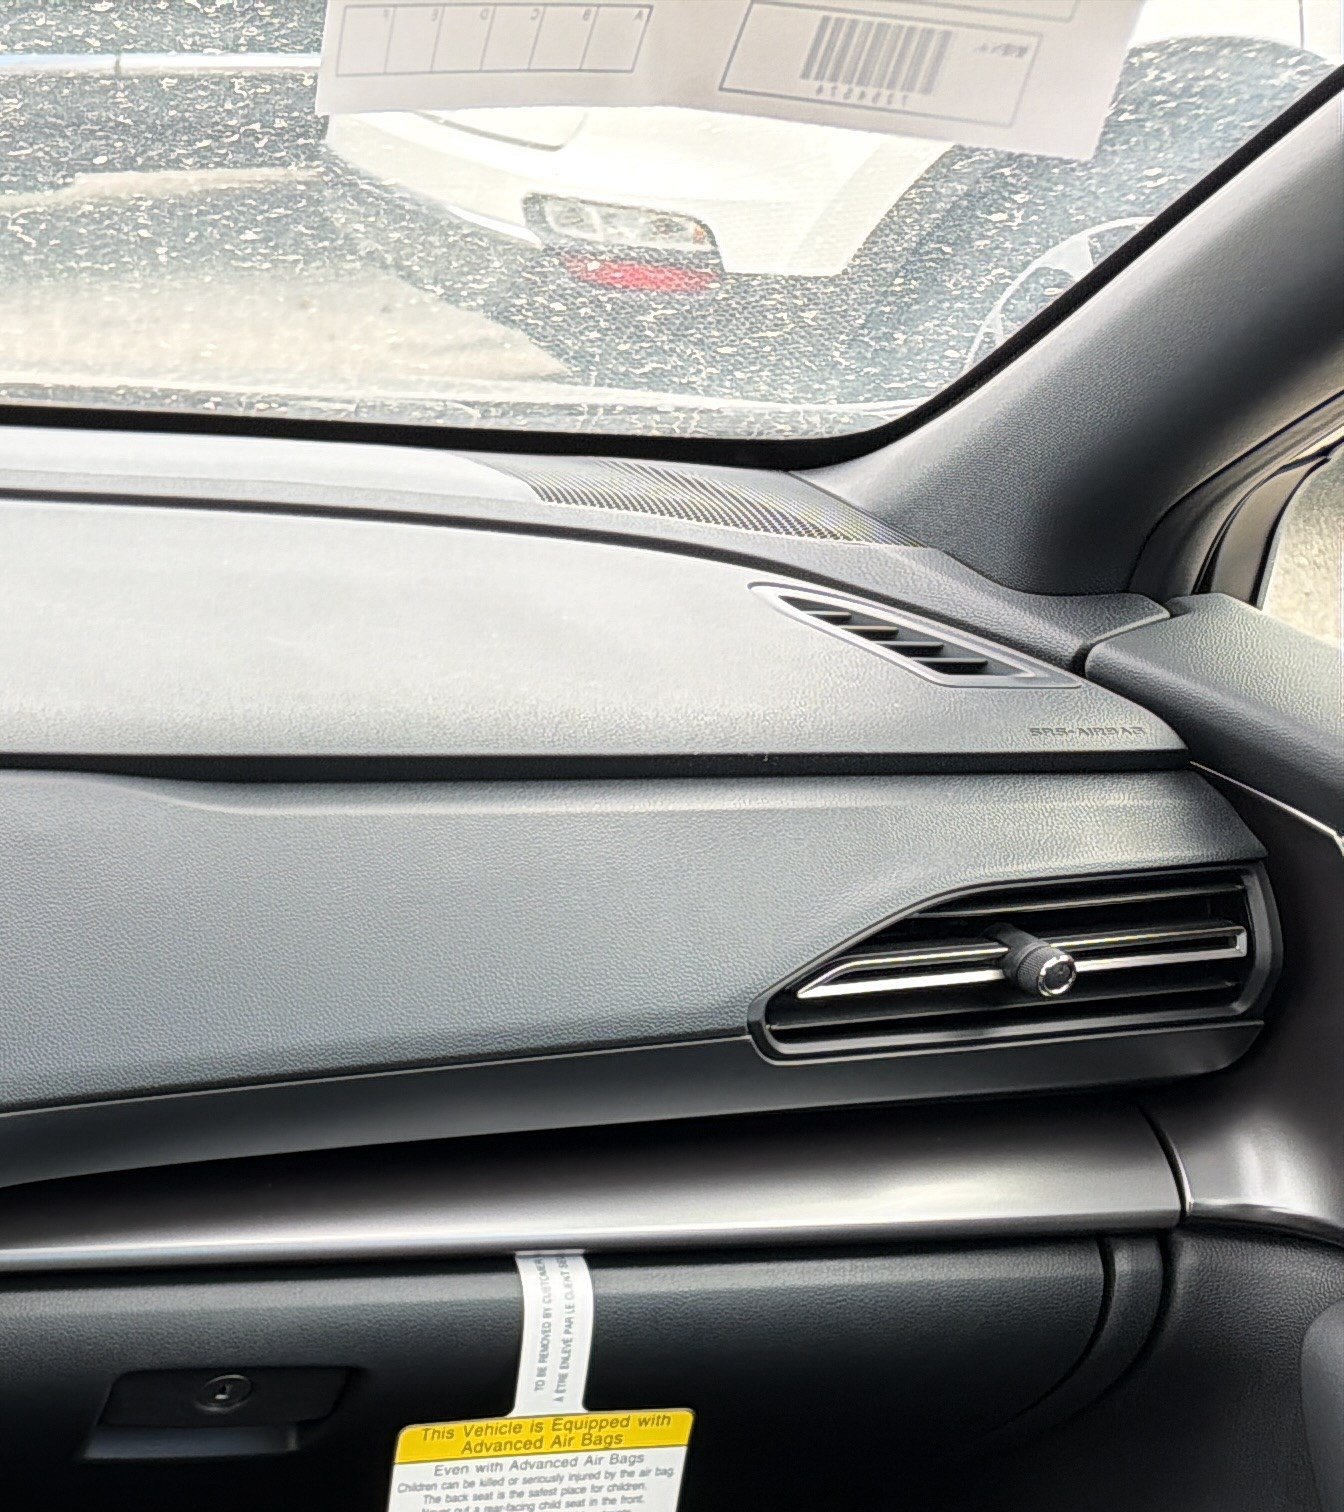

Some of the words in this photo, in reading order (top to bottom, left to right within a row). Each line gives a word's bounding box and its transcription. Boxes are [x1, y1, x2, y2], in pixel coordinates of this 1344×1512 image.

[421, 1427, 455, 1442] This
[462, 1421, 523, 1439] Vehicle
[529, 1420, 544, 1434] is
[551, 1415, 631, 1434] Equipped
[638, 1414, 672, 1427] with
[461, 1436, 544, 1455] Advanced
[550, 1434, 576, 1449] Air
[581, 1432, 624, 1449] Bags
[433, 1464, 470, 1477] Even
[475, 1462, 504, 1474] with
[508, 1456, 579, 1472] Advanced
[583, 1454, 606, 1467] Air
[609, 1452, 645, 1467] Bags
[397, 1481, 438, 1494] Children
[440, 1480, 460, 1491] can
[462, 1479, 476, 1490] be
[568, 1470, 602, 1484] injured
[604, 1469, 617, 1482] by
[423, 1493, 442, 1505] The
